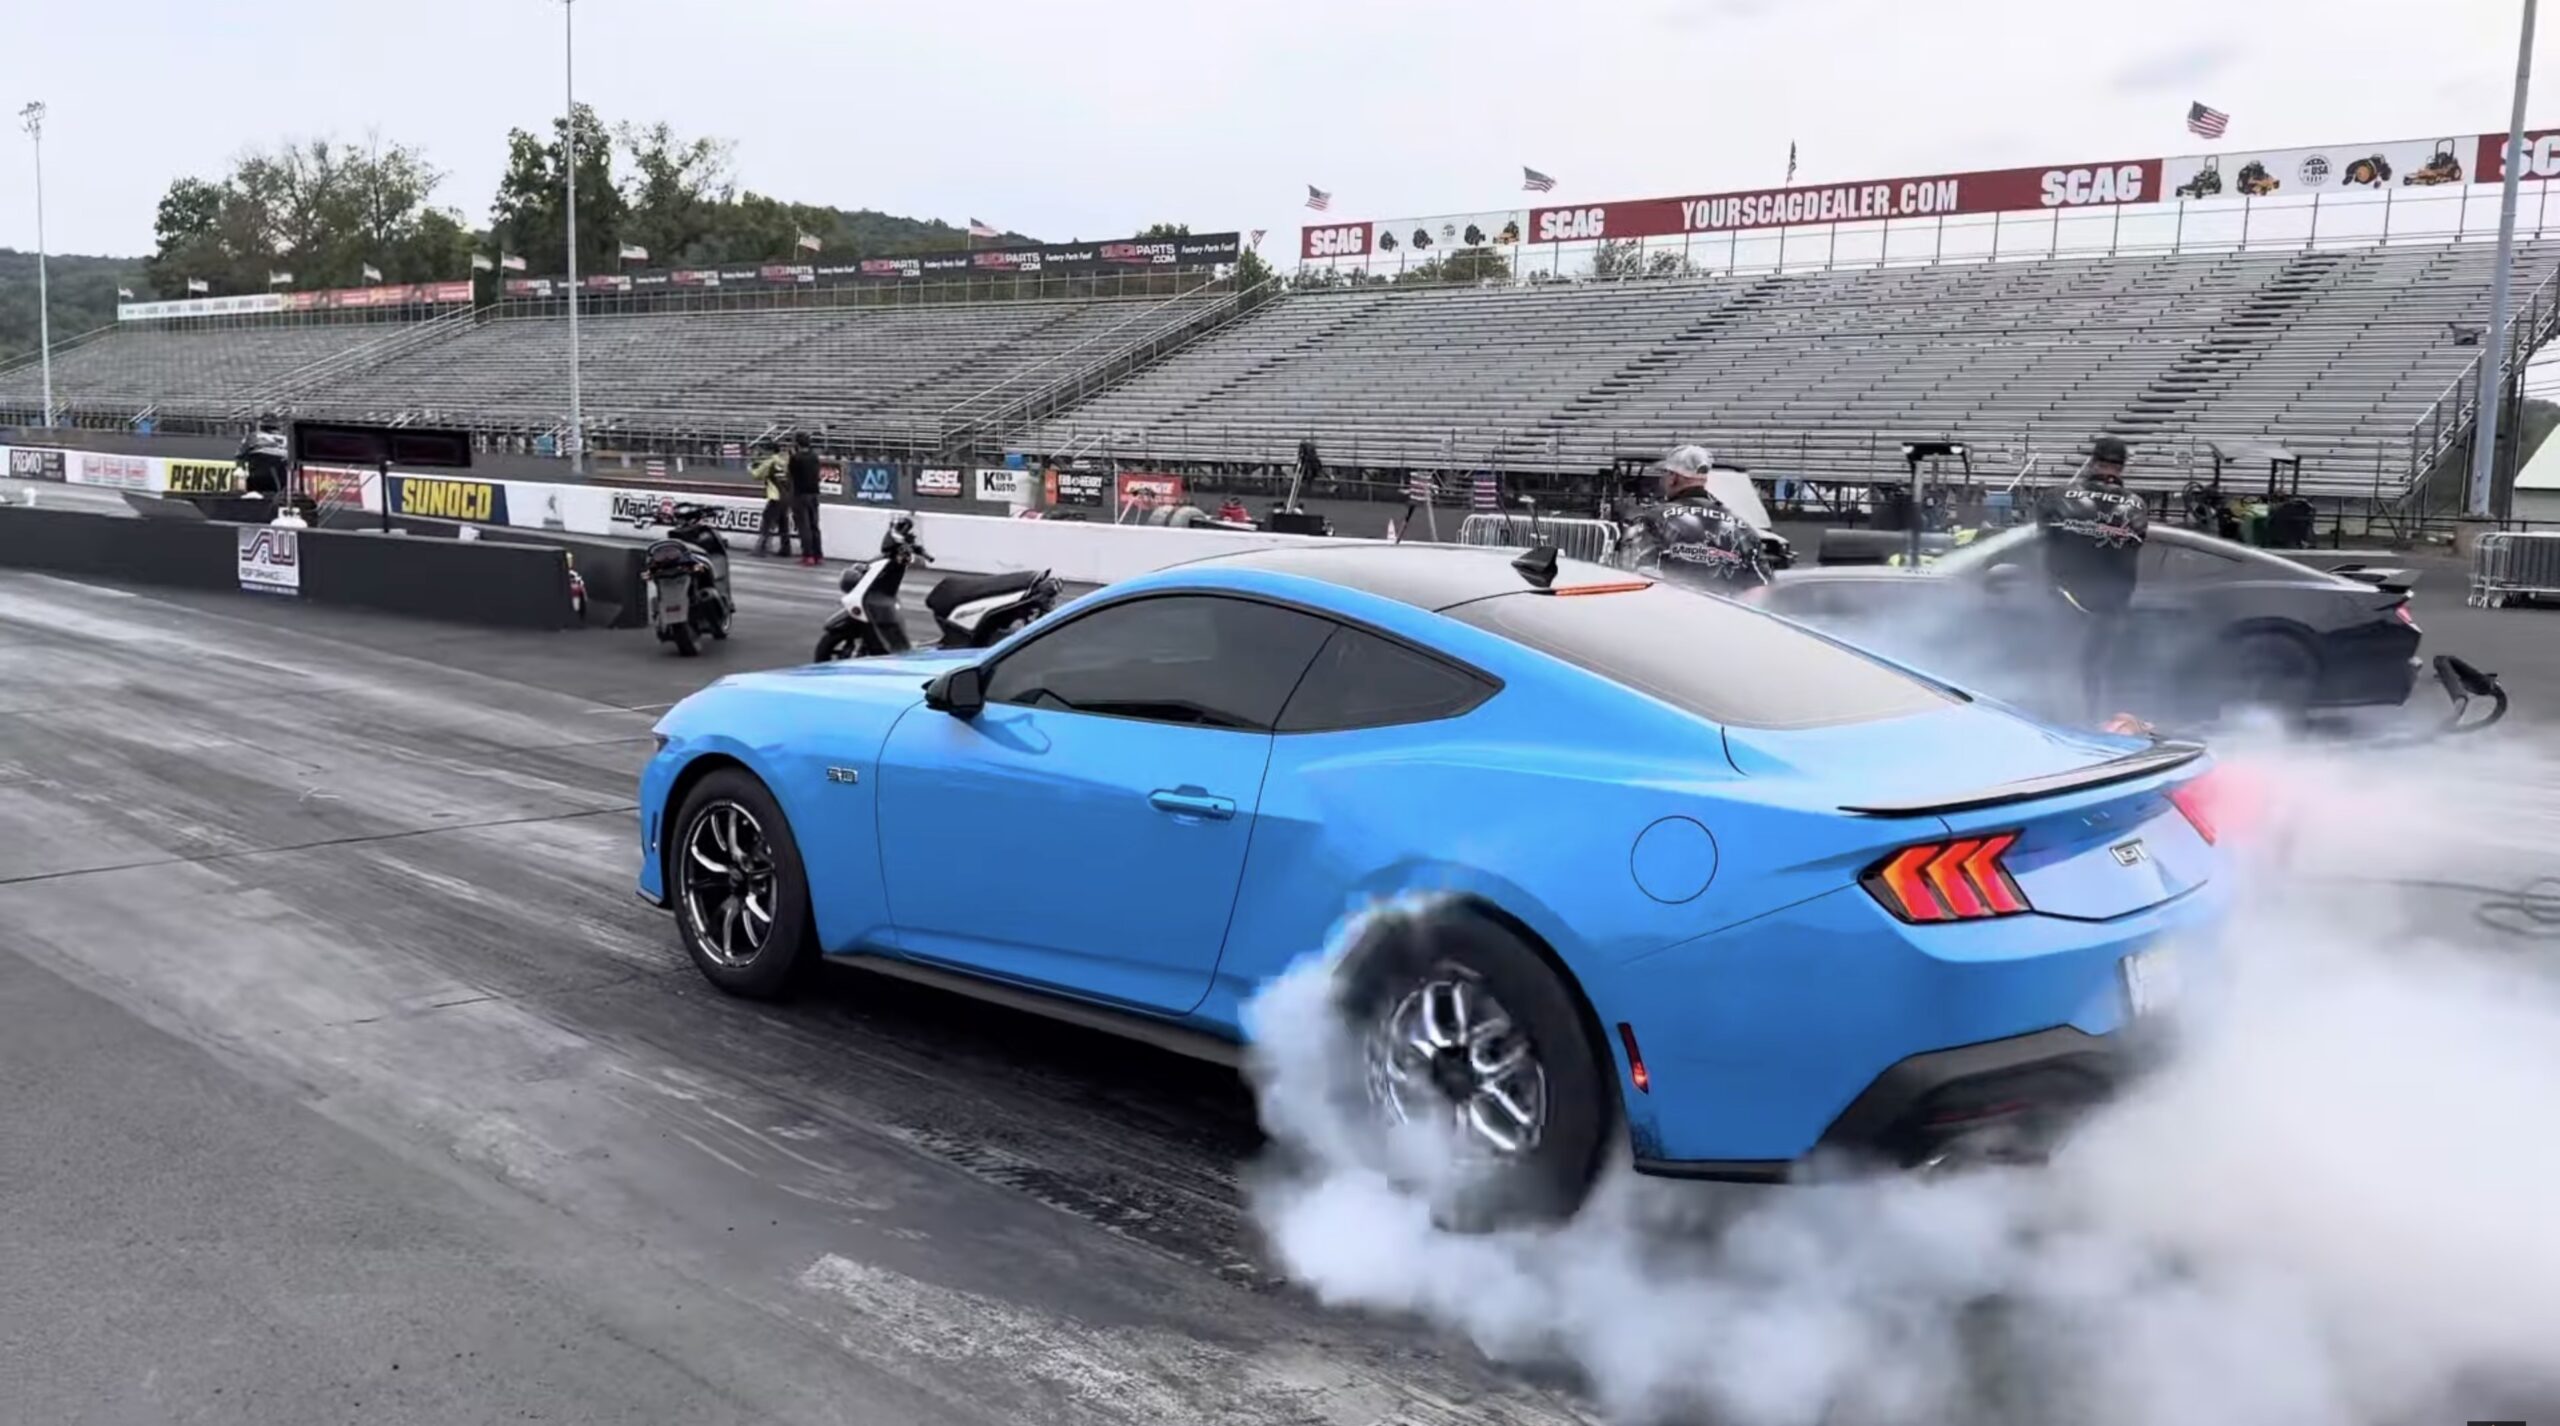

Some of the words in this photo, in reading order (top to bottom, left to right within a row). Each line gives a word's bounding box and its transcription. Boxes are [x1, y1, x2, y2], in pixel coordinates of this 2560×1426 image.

[2040, 165, 2143, 206] SCAG
[1682, 179, 1959, 230] YOURSCAGDEALER.COM
[1539, 208, 1605, 240] SCAG
[1310, 226, 1363, 255] SCAG
[170, 464, 232, 491] PENSK
[916, 469, 961, 488] JESEL
[401, 478, 492, 520] SUNOCO
[2064, 490, 2142, 509] OFFICIAL
[1663, 506, 1748, 529] OFFICIAL
[2109, 837, 2149, 867] GT
